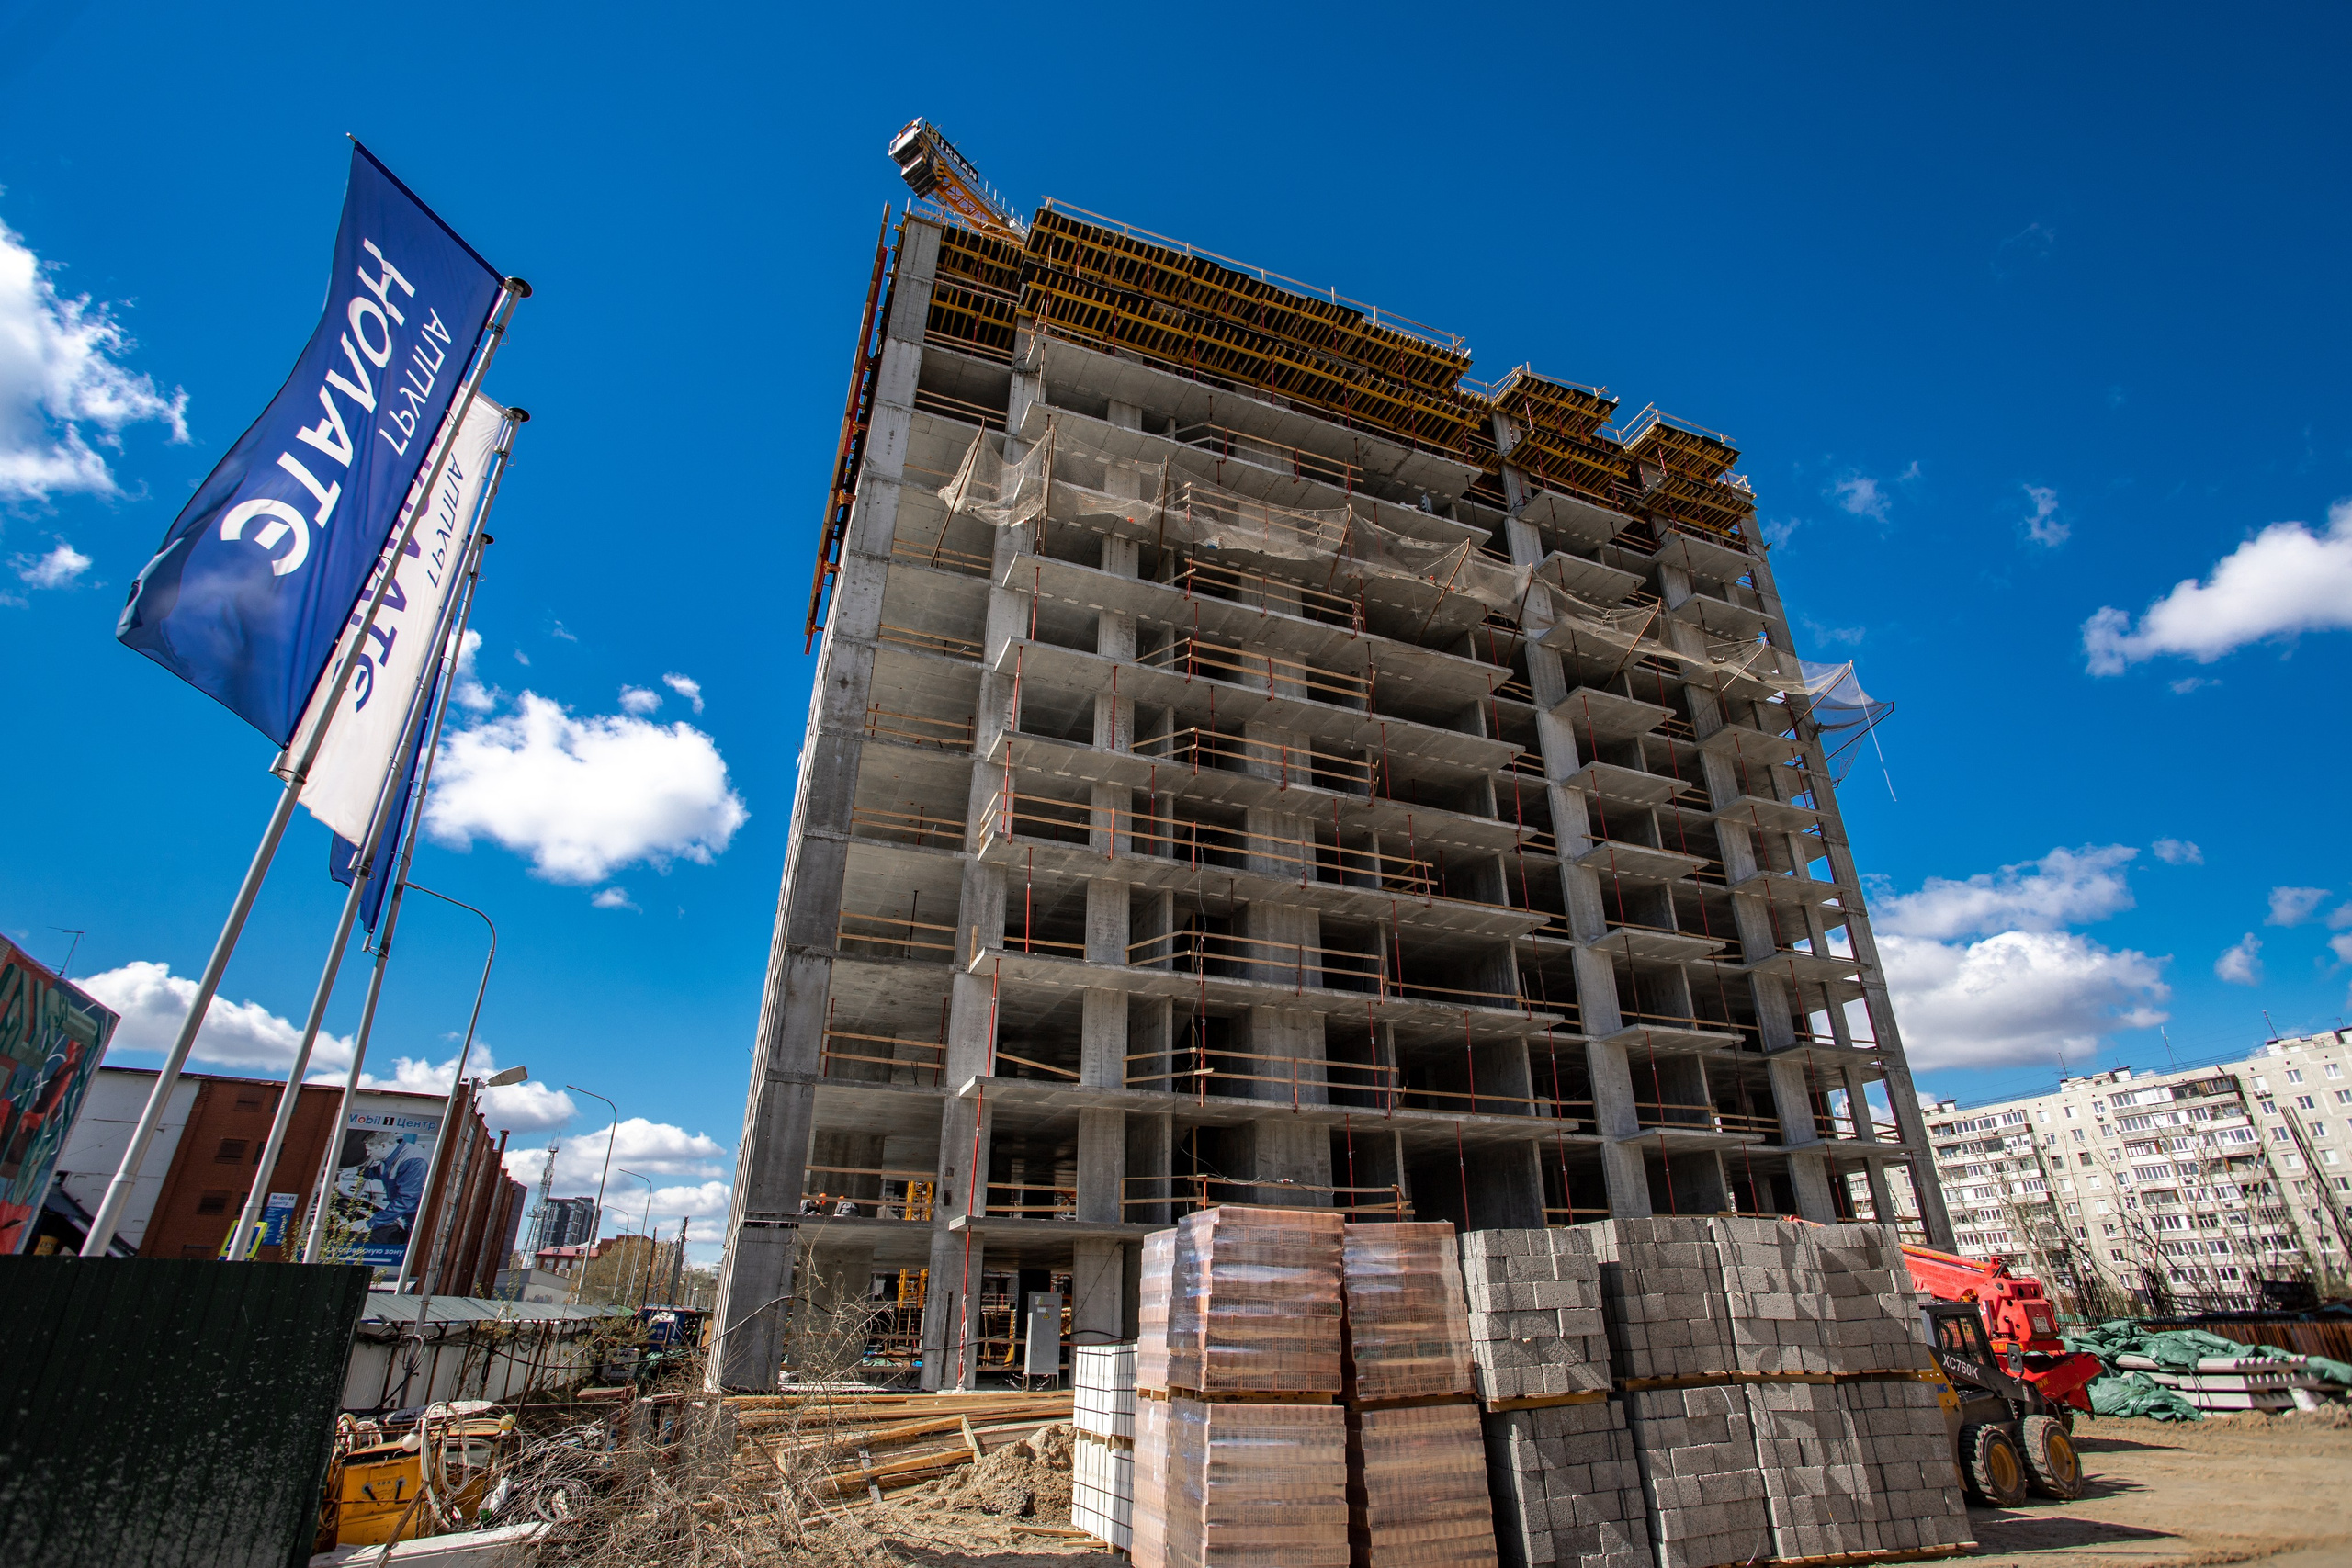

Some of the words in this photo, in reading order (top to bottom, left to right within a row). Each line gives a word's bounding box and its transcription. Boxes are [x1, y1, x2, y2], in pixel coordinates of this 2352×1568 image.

[349, 1113, 381, 1125] Mobil
[396, 1118, 436, 1131] Центр
[384, 1248, 404, 1258] зону
[1942, 1353, 1980, 1380] XC760K
